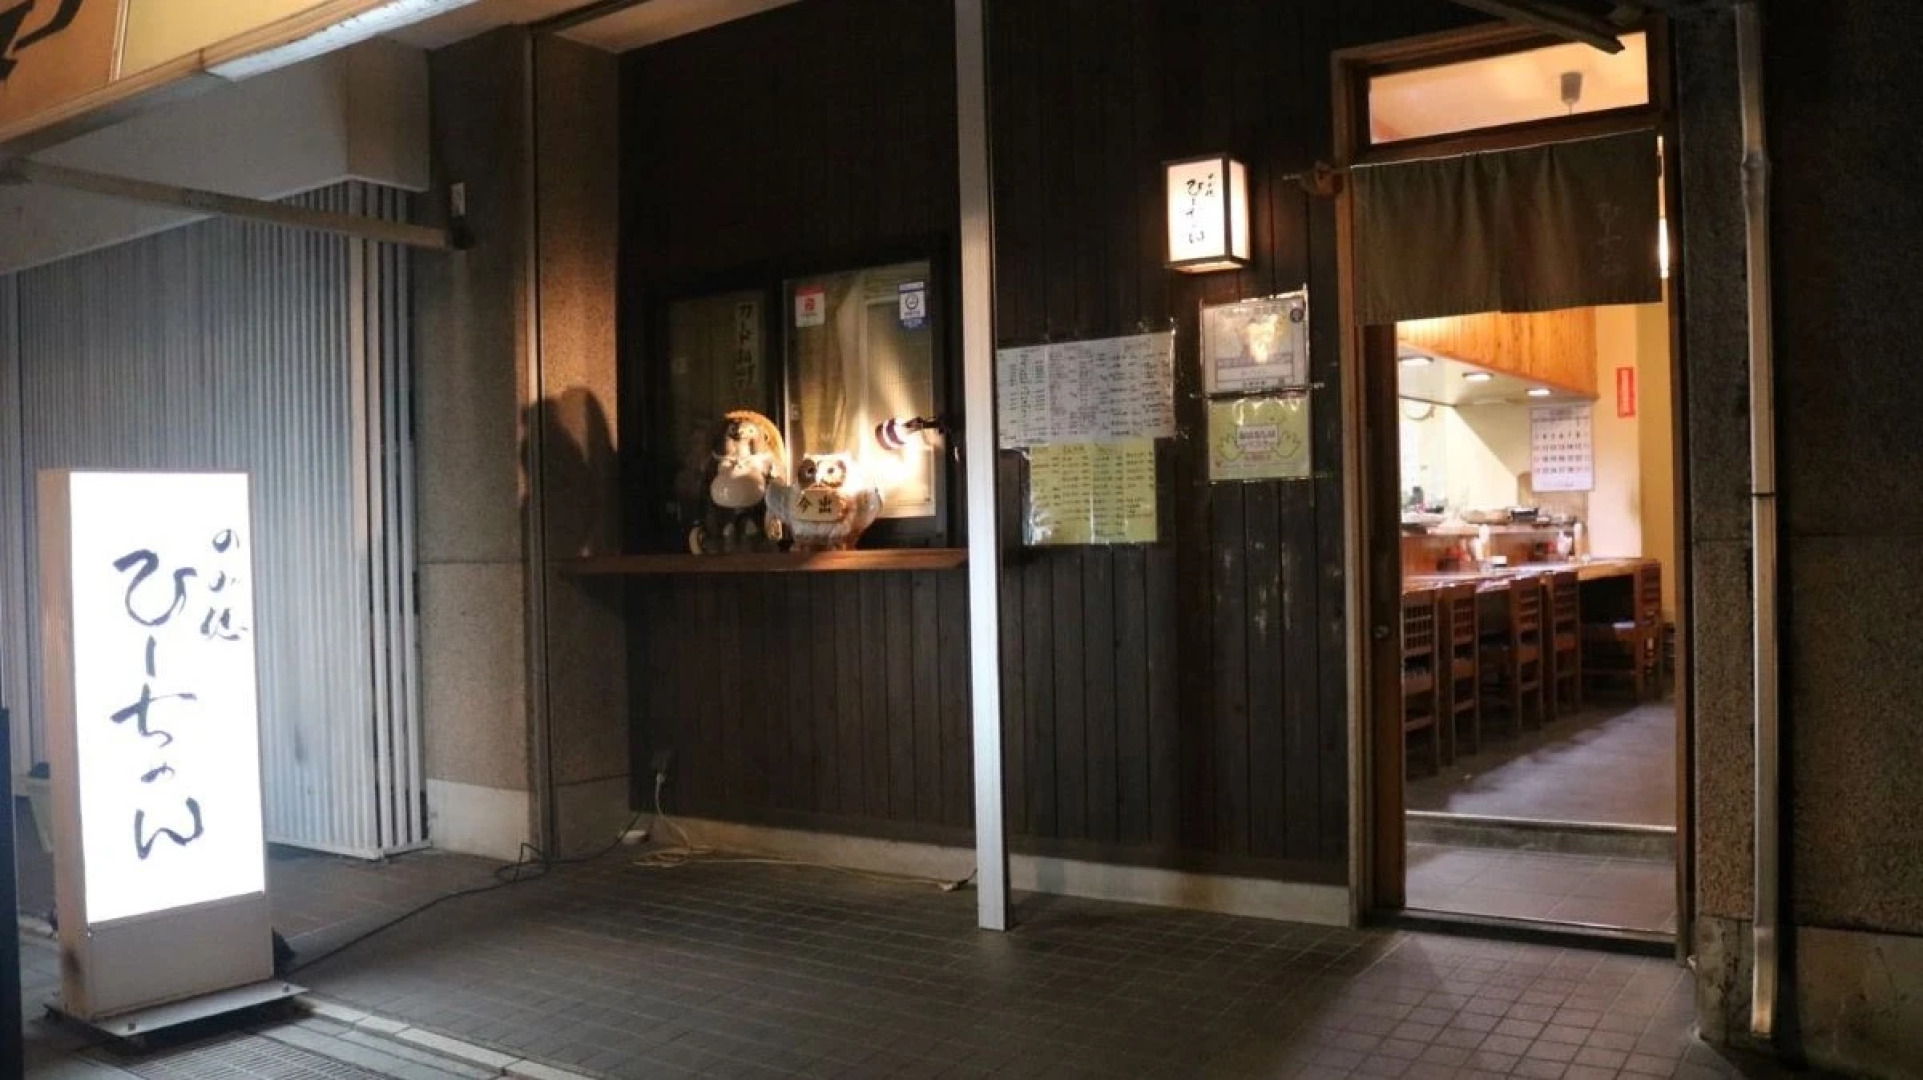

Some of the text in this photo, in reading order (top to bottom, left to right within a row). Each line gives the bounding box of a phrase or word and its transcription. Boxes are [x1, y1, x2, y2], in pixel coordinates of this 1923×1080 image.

[111, 548, 204, 861] ひーちゃん
